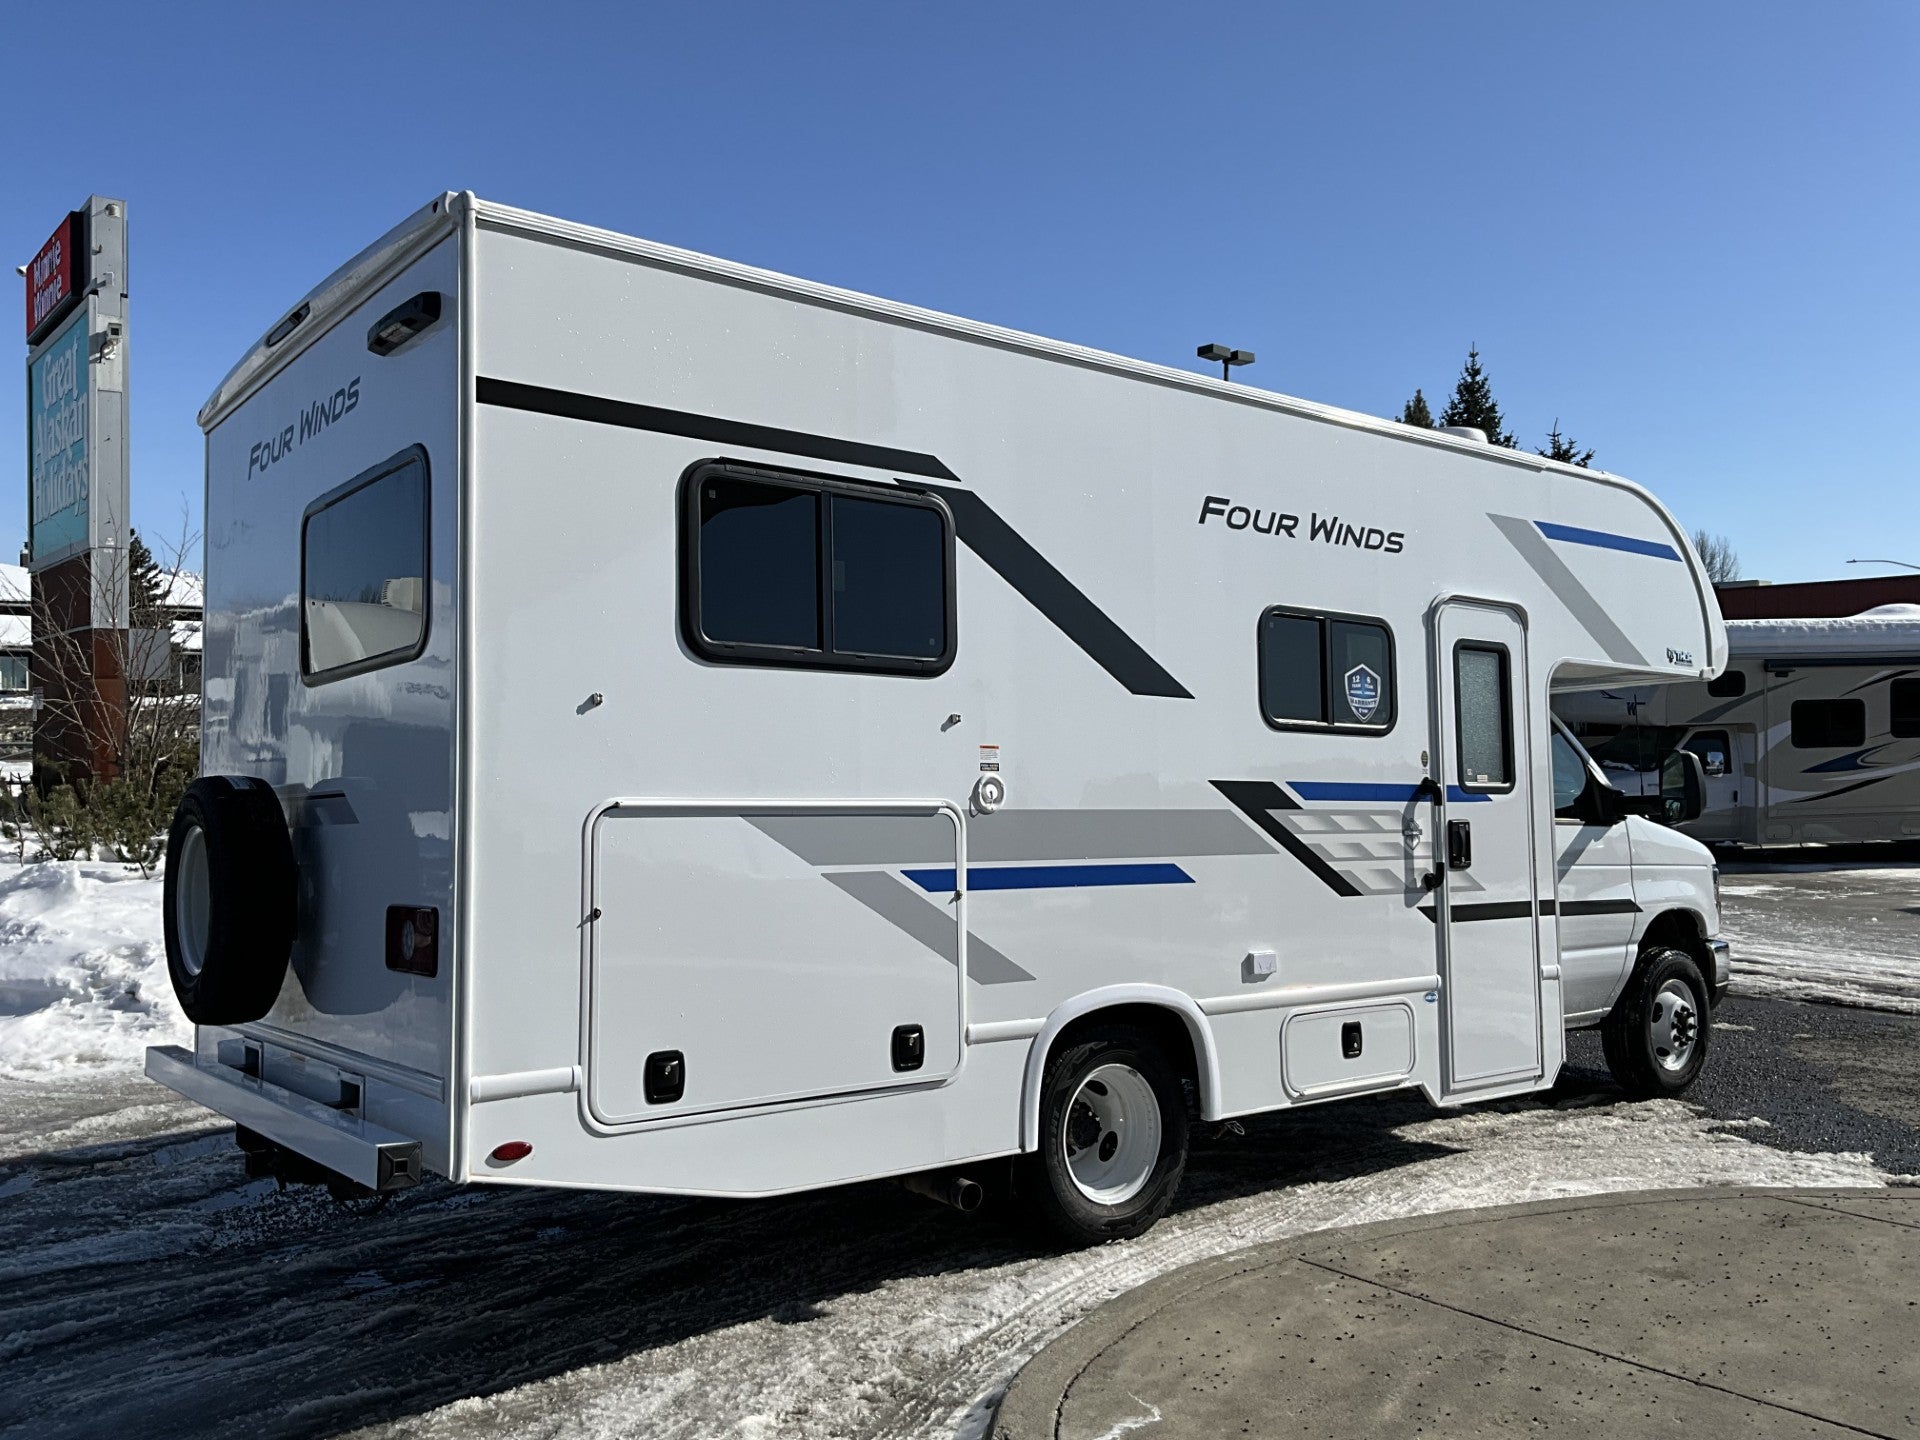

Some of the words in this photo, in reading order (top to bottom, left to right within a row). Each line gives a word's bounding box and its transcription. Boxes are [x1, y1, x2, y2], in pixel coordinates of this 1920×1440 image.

[42, 333, 80, 410] Great
[34, 392, 88, 471] Alaskan
[248, 424, 295, 481] FOUR
[299, 375, 361, 446] WINDS
[32, 457, 89, 526] Holidays
[1198, 495, 1300, 538] FOUR
[1309, 512, 1405, 554] WINDS
